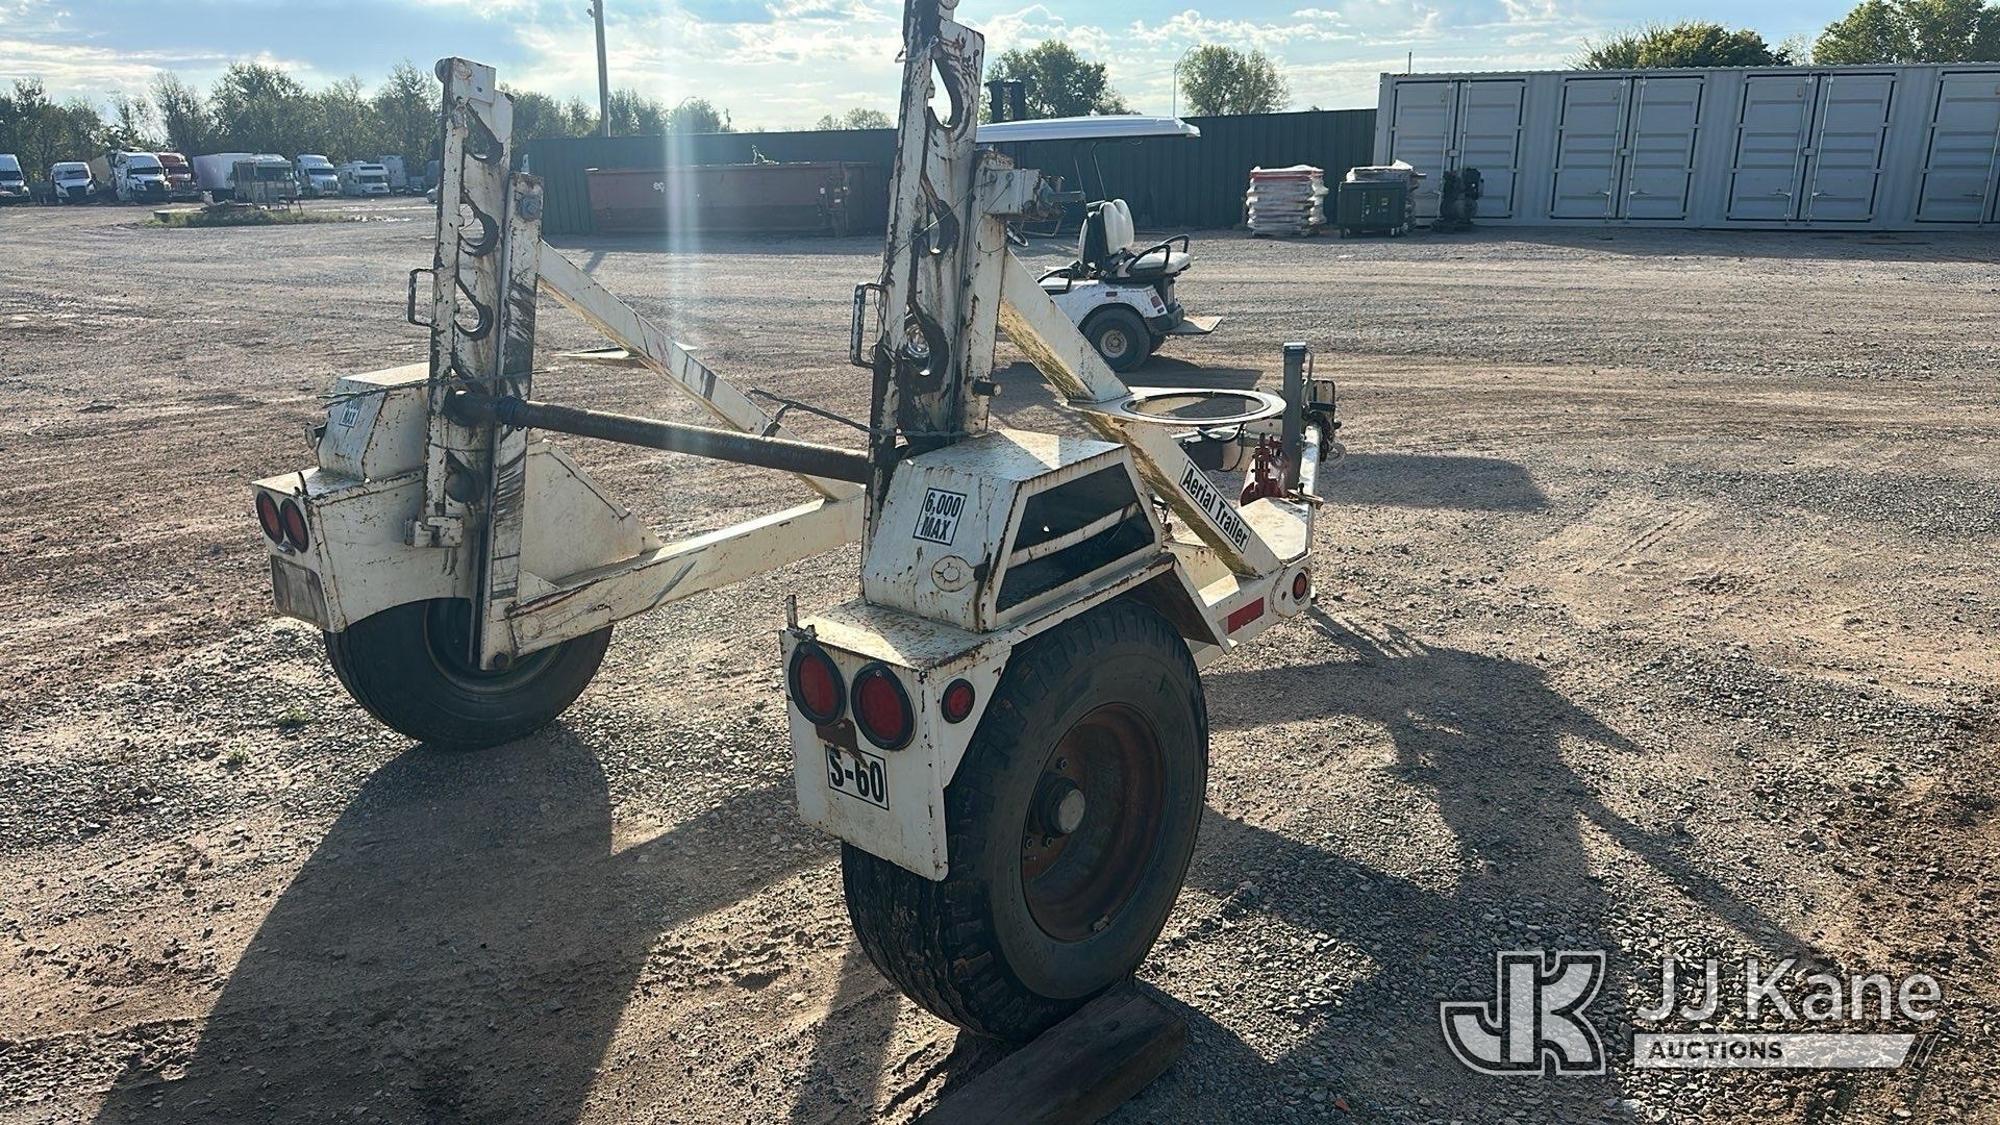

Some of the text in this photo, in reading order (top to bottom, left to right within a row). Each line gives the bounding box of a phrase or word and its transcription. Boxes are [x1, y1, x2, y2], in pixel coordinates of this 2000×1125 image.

[924, 491, 962, 518] 6,000
[1182, 468, 1248, 546] Aerial Trailer
[920, 515, 952, 541] MAX
[828, 747, 885, 803] S-60
